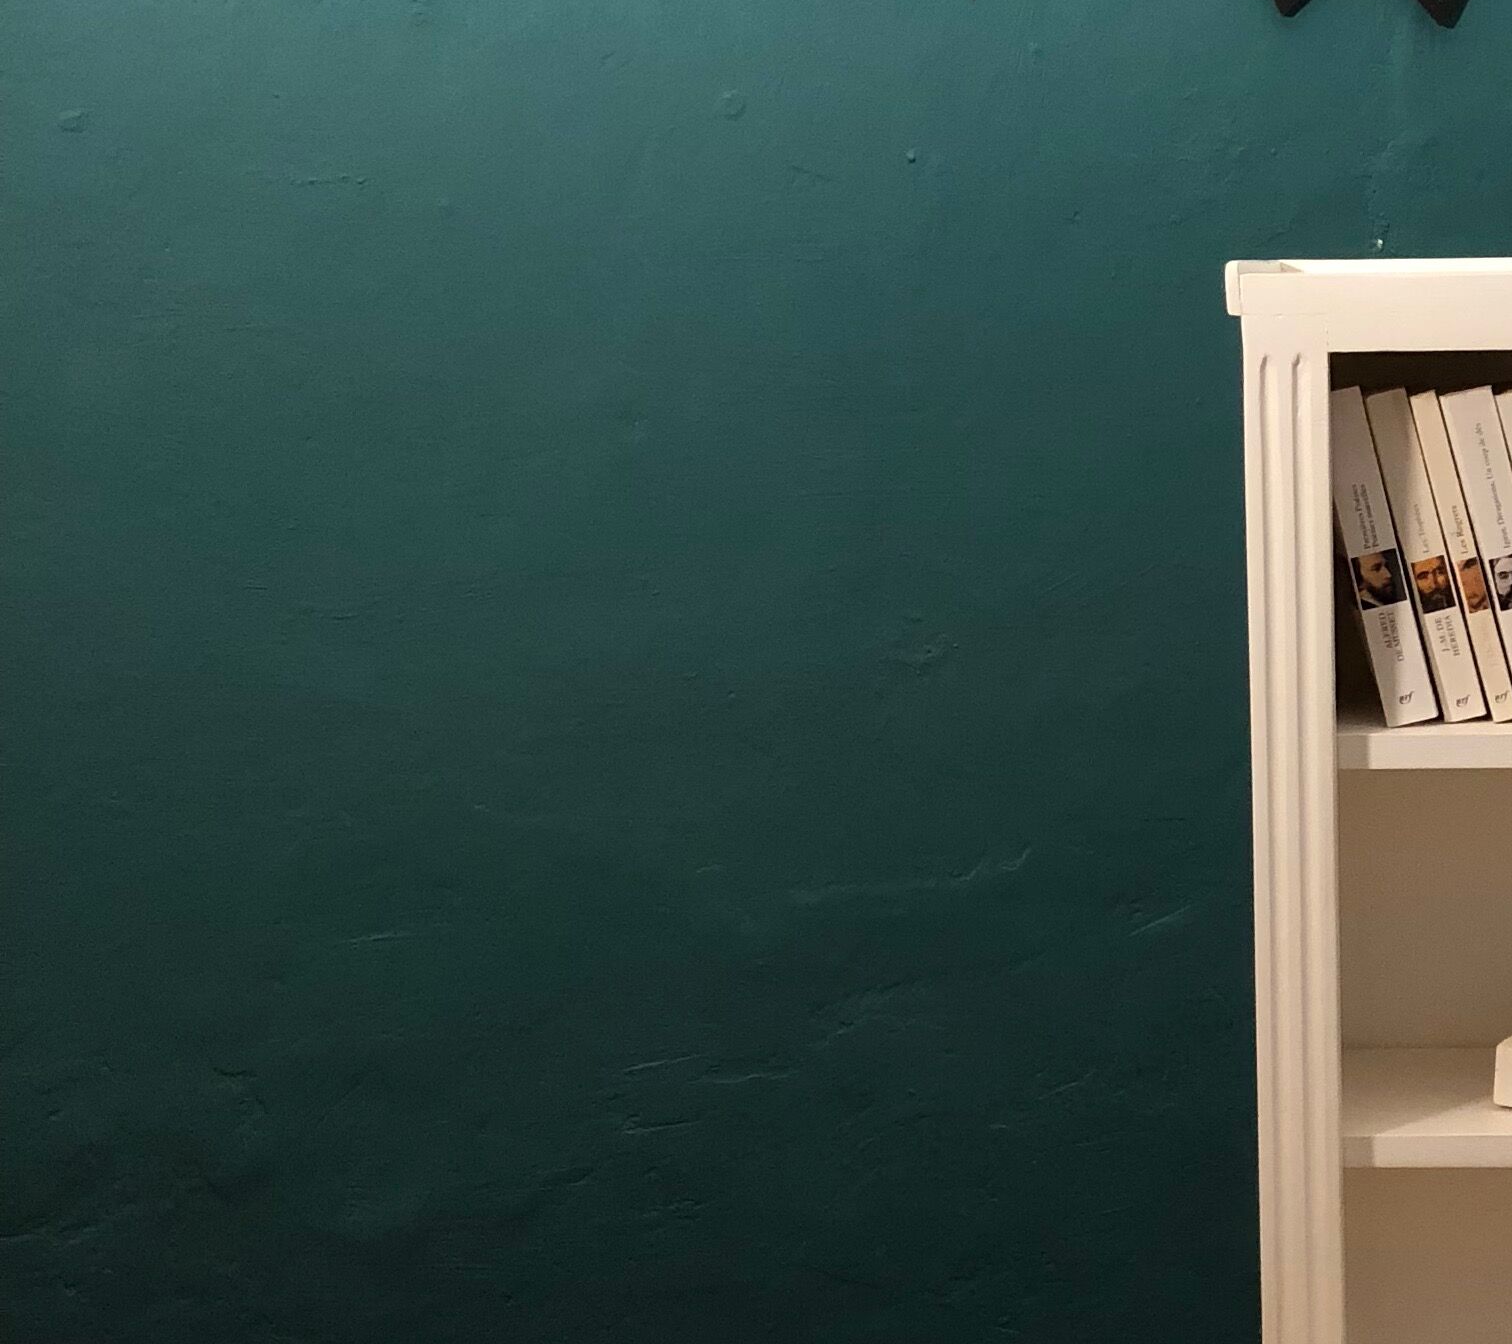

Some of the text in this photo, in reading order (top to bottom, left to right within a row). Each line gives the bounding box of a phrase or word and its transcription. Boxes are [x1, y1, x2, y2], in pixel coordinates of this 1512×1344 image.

[1451, 505, 1469, 554] Les Regrets
[1379, 612, 1394, 649] ALFRED
[1387, 612, 1404, 662] DE MUSSET
[1434, 617, 1444, 632] DE
[1444, 614, 1461, 657] HEREDIA
